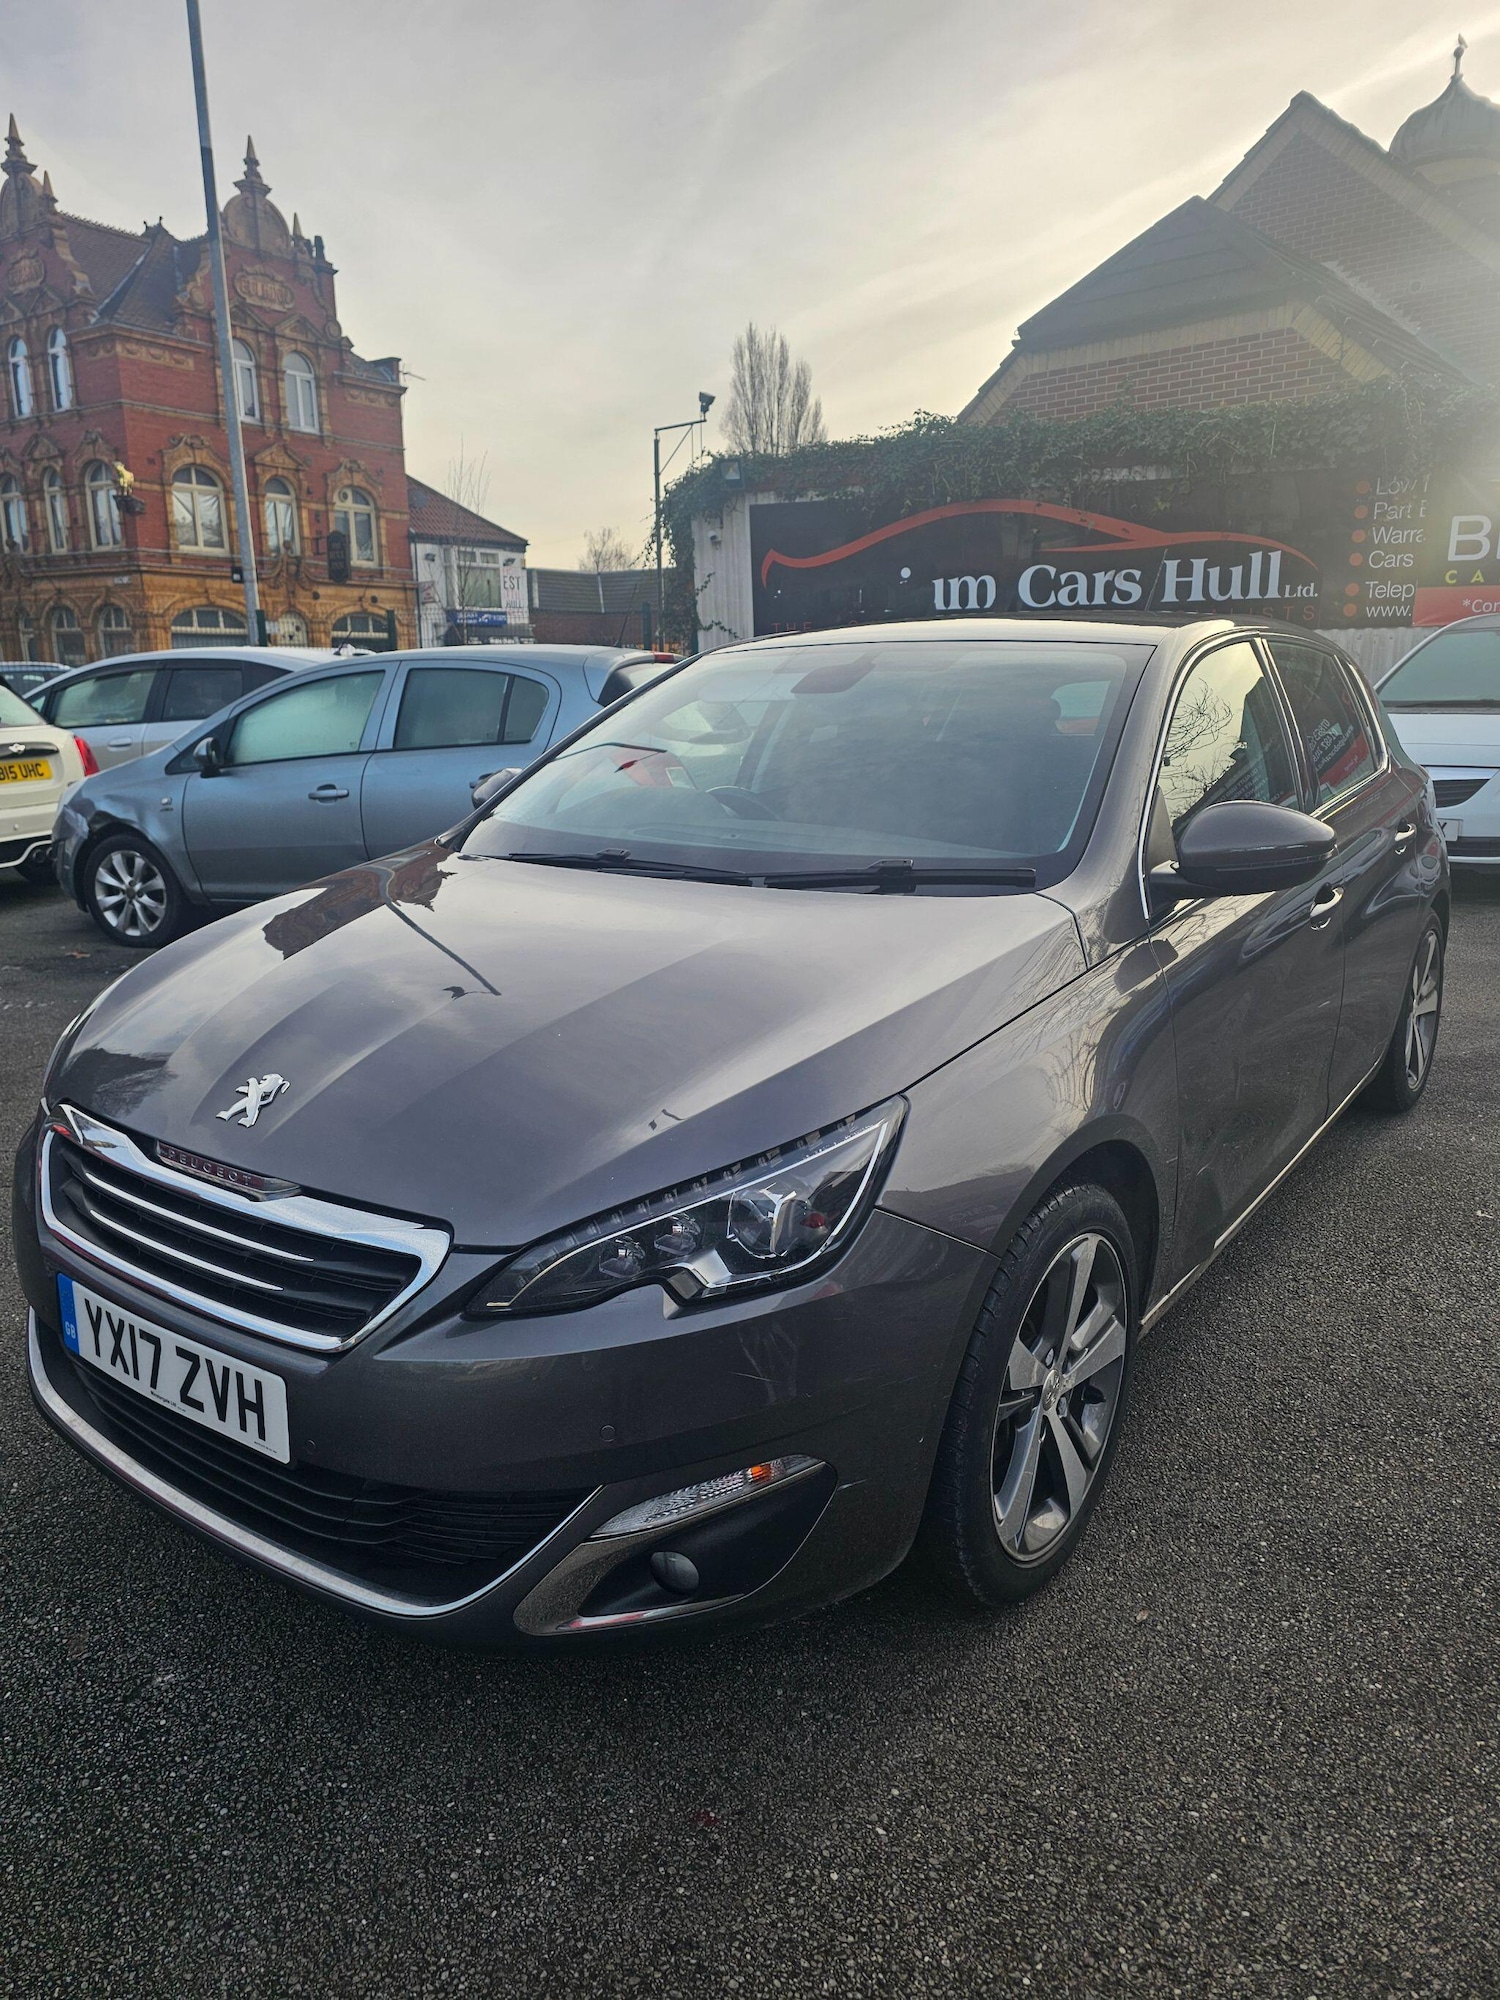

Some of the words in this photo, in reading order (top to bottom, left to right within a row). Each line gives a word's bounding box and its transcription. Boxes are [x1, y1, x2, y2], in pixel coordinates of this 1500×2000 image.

[1373, 501, 1412, 520] Part
[1447, 514, 1500, 562] B
[1368, 550, 1414, 569] Cars
[1018, 564, 1142, 608] Cars
[1160, 549, 1282, 603] Hull
[1284, 582, 1319, 599] Ltd.
[1365, 580, 1415, 602] Telep
[1366, 604, 1412, 618] www.
[18, 763, 44, 778] UHC
[168, 1150, 252, 1186] PEUGEOT
[65, 1321, 76, 1339] GB
[84, 1298, 162, 1390] YX17
[175, 1345, 266, 1442] ZVH
